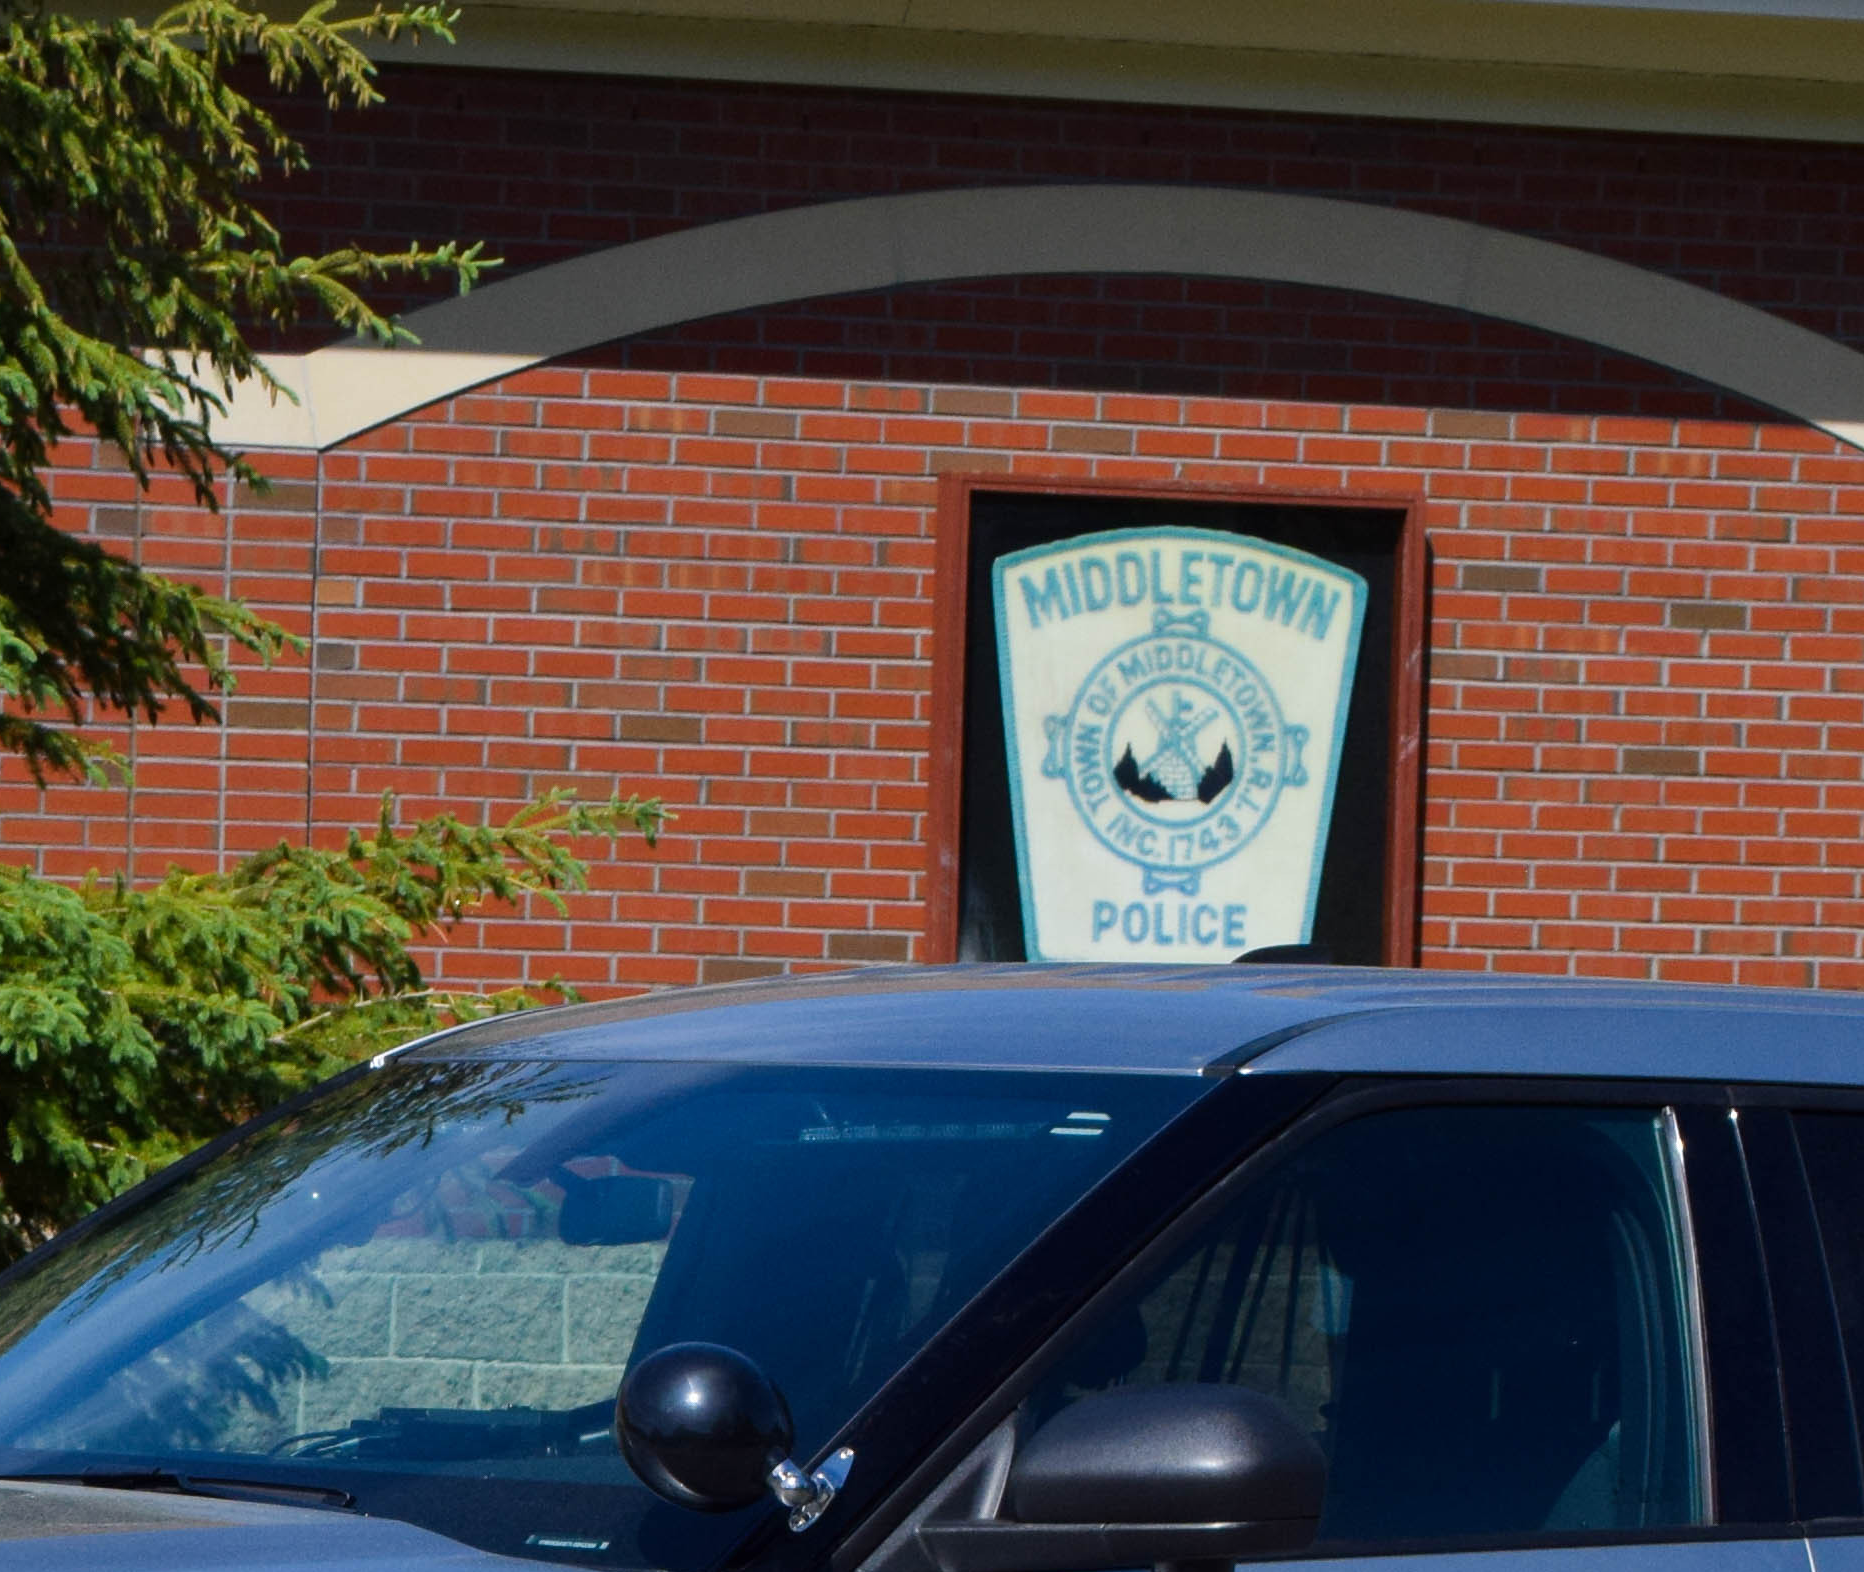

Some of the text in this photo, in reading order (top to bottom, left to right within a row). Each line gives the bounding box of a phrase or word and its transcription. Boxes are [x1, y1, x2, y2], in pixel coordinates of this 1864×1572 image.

[1018, 549, 1340, 641] MIDDLETOWN
[1087, 677, 1118, 715] OF
[1075, 724, 1109, 814] TOWN
[1170, 813, 1241, 863] 1743
[1092, 902, 1246, 947] POLICE
